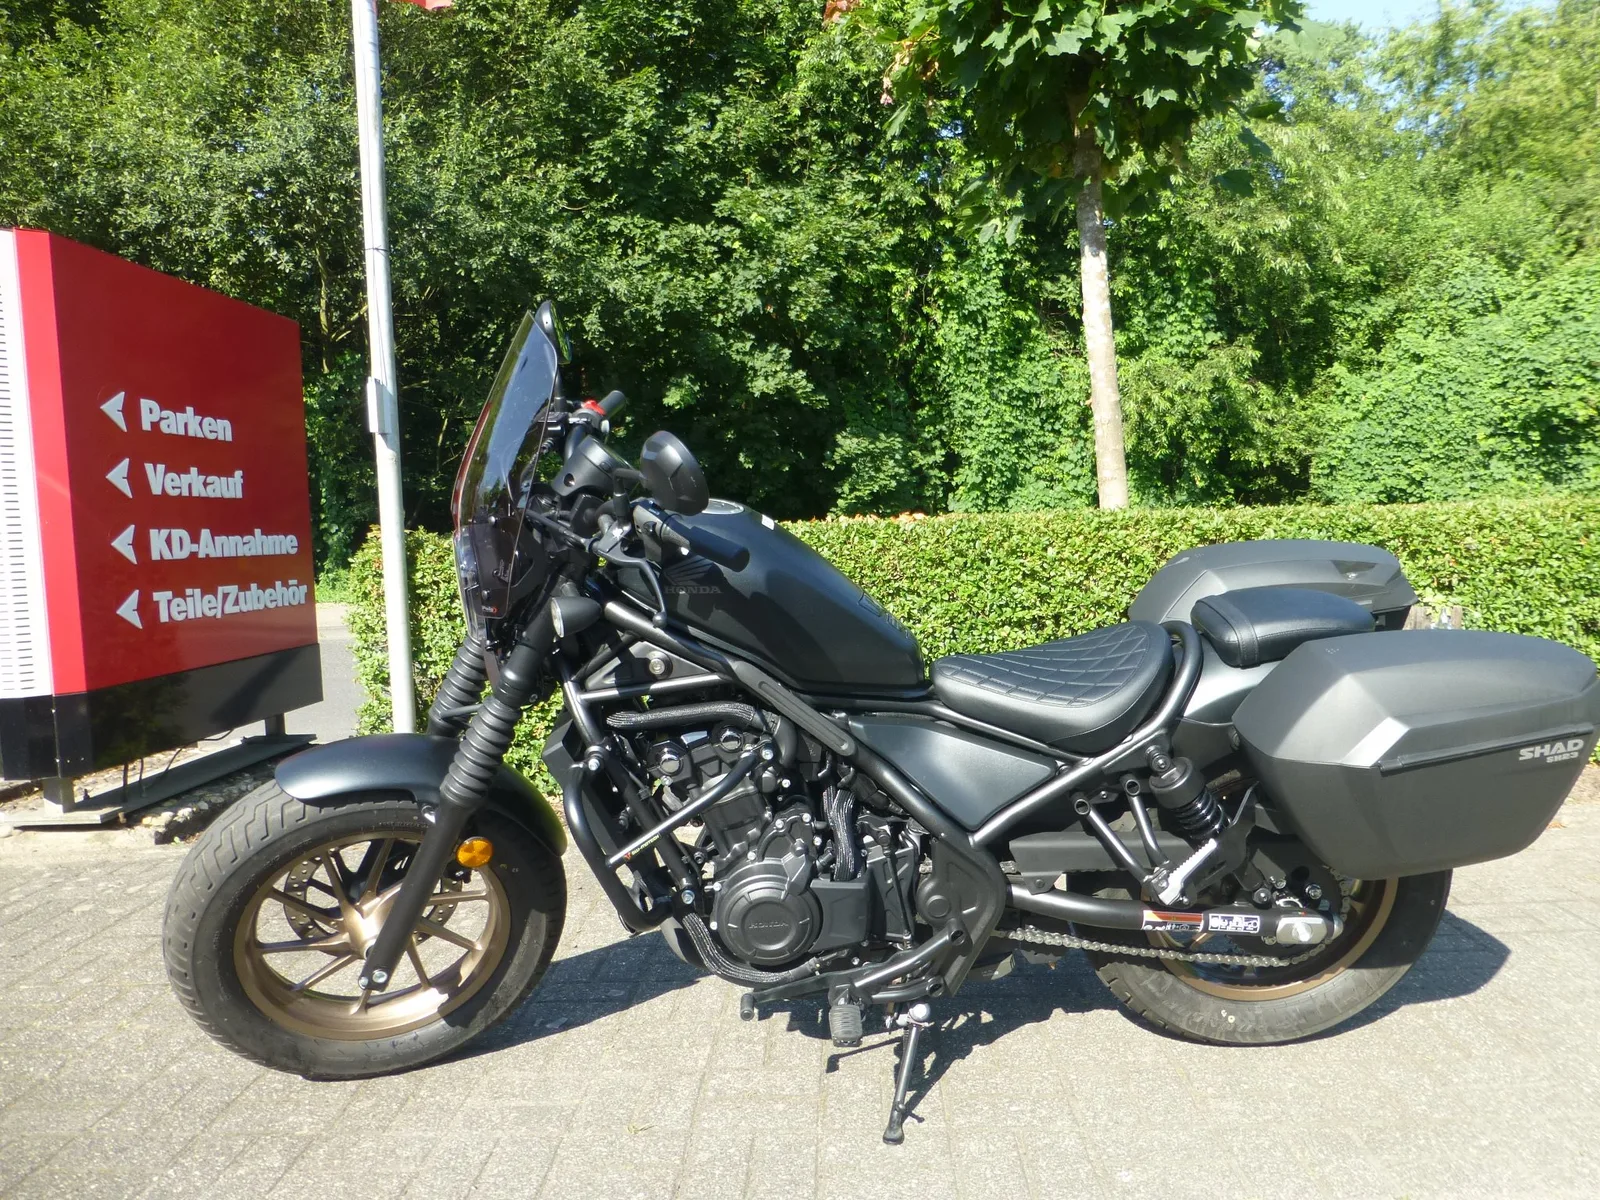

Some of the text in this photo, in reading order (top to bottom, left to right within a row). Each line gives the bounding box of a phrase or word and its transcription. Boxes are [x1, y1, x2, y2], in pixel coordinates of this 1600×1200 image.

[140, 398, 233, 442] Parken
[144, 463, 244, 499] Verkauf
[150, 528, 298, 560] KD-Annahme
[153, 579, 308, 623] Teile/Zubehör
[664, 585, 723, 594] HONDA
[1519, 739, 1584, 761] SHAD
